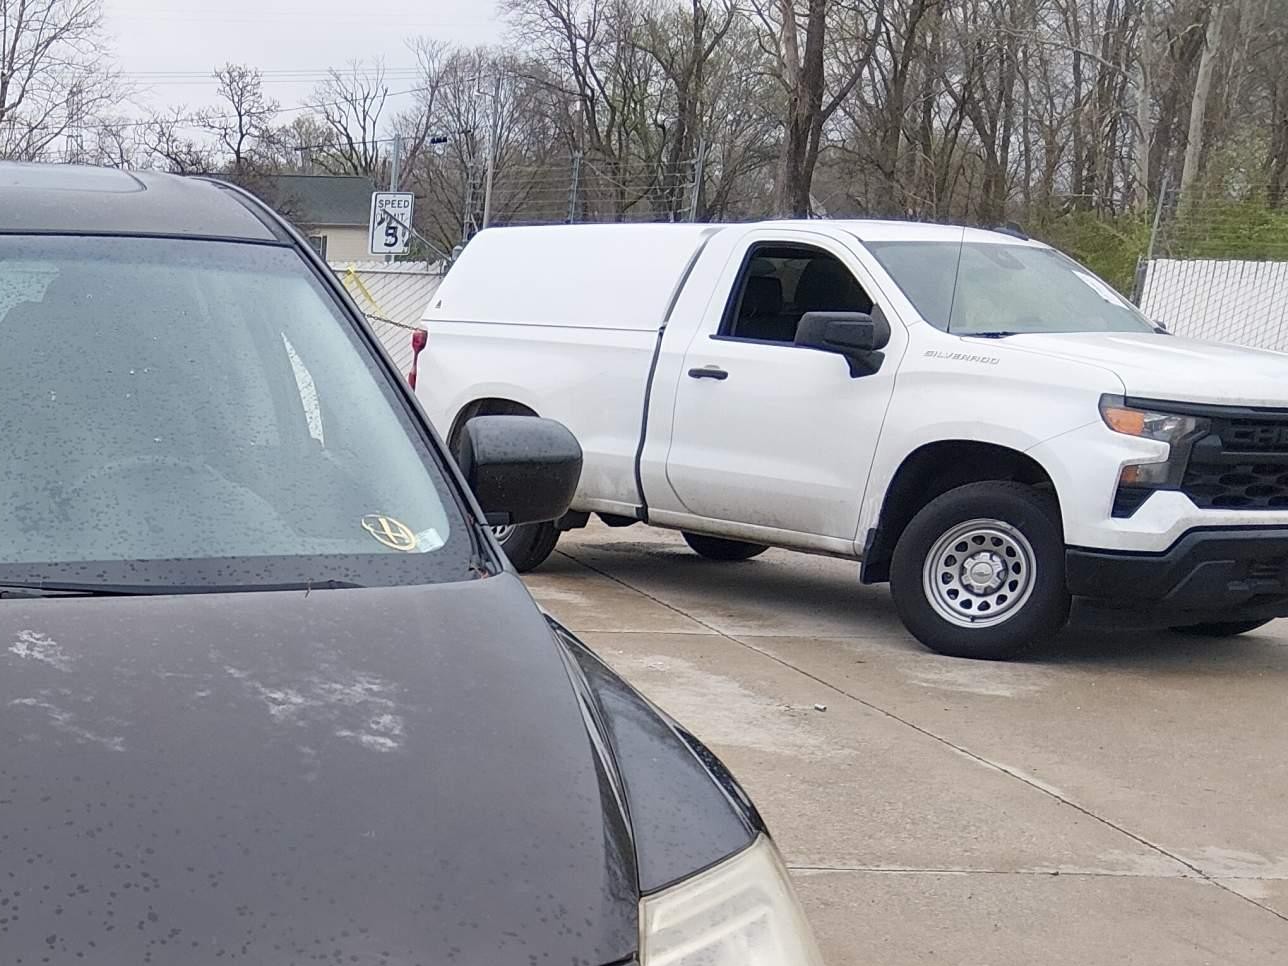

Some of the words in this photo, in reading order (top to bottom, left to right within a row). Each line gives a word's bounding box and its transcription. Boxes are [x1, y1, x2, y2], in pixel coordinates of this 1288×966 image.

[378, 199, 410, 209] SPEED
[384, 226, 398, 248] 5
[923, 350, 1001, 365] SILVERADO
